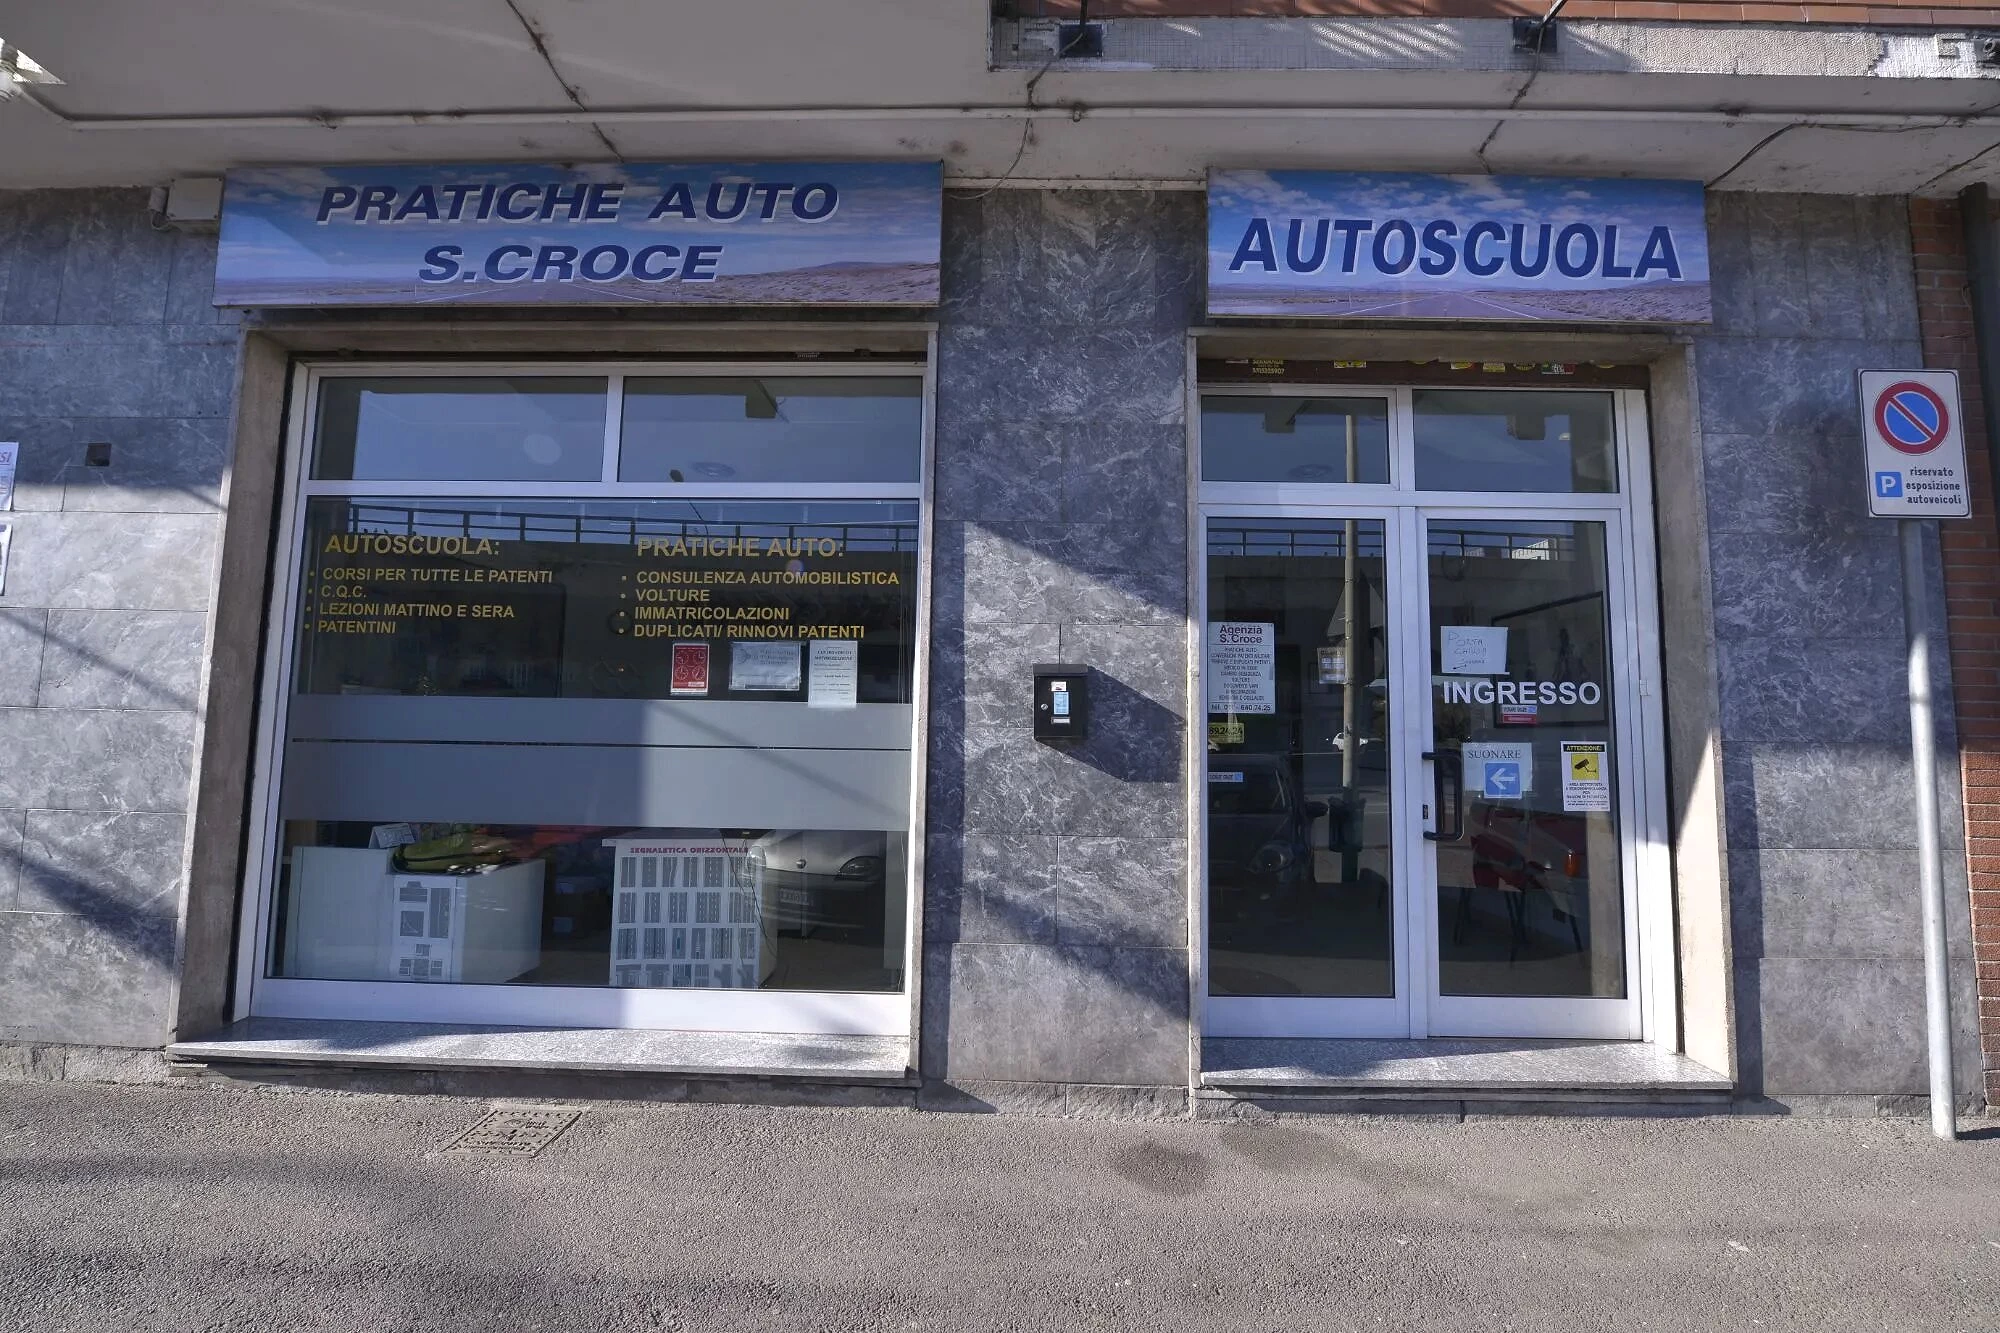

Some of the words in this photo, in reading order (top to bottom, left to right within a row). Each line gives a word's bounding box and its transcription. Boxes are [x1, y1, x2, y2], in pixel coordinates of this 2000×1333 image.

[315, 182, 625, 225] PRATICHE
[647, 181, 840, 224] AUTO
[1228, 217, 1686, 282] AUTOSCUOLA
[418, 244, 725, 284] S.CROCE
[1909, 466, 1954, 477] riservato
[1905, 480, 1961, 492] esposizione
[1907, 494, 1962, 505] autoveicoli
[324, 534, 501, 556] AUTOSCUOLA:
[636, 537, 760, 557] PRATICHE
[766, 538, 845, 558] AUTO:
[322, 567, 371, 581] CORSI
[375, 568, 406, 582] PER
[411, 569, 460, 582] TUTTE
[464, 569, 484, 583] LE
[488, 570, 554, 584] PATENTI
[636, 571, 747, 585] CONSULENZA
[749, 571, 900, 585] AUTOMOBILISTICA
[321, 585, 368, 598] C.Q.C.
[634, 588, 710, 602] VOLTURE
[319, 603, 380, 616] LEZIONI
[383, 603, 453, 617] MATTINO
[457, 604, 467, 617] E
[471, 604, 515, 618] SERA
[634, 607, 790, 621] IMMATRICOLAZIONI
[317, 620, 397, 634] PATENTINI
[634, 624, 723, 638] DUPLICATI/
[727, 625, 793, 639] RINNOVI
[798, 625, 865, 639] PATENTI
[1219, 624, 1263, 636] Agenzia
[1219, 635, 1230, 644] S.
[1231, 635, 1263, 644] Croce
[1443, 680, 1601, 705] INGRESSO
[1468, 749, 1521, 759] SUONARE
